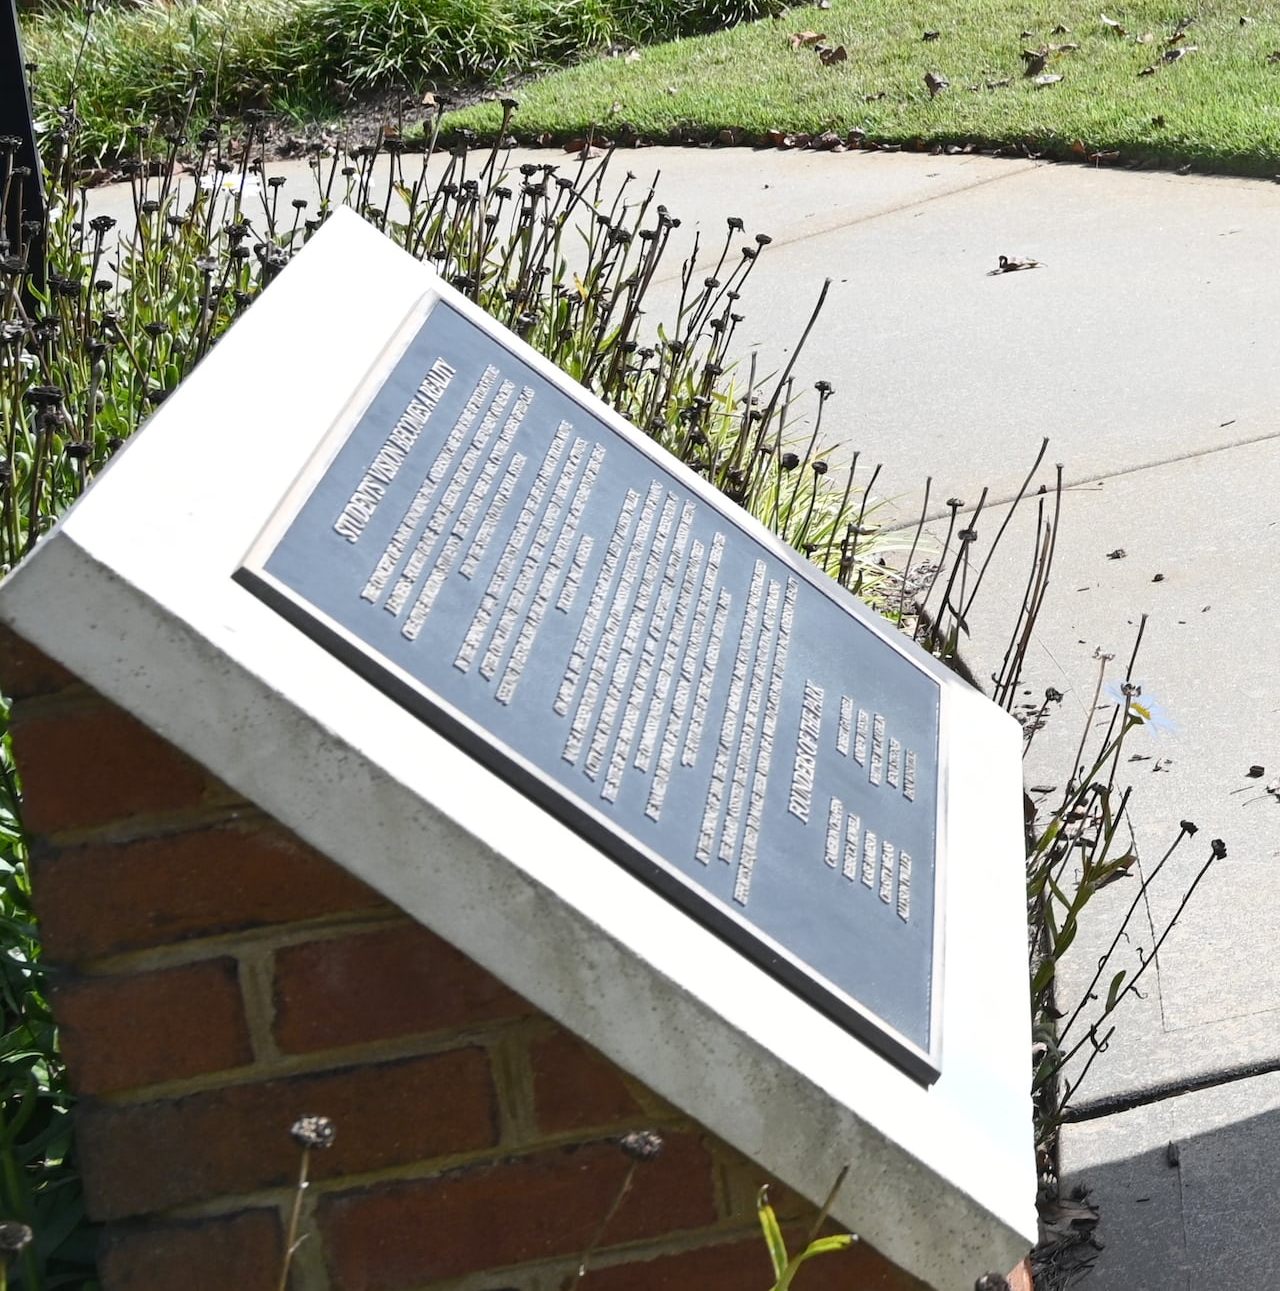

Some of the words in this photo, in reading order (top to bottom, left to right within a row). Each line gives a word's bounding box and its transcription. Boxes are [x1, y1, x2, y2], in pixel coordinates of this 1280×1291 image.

[412, 388, 437, 412] A
[416, 354, 458, 404] REALITY
[386, 396, 433, 454] BECOMES
[365, 438, 408, 488] VISION
[331, 471, 389, 545] STUDENTS'
[802, 676, 825, 719] PARK
[796, 728, 819, 760] OF
[799, 705, 821, 743] THE
[787, 747, 816, 825] FOUNDERS
